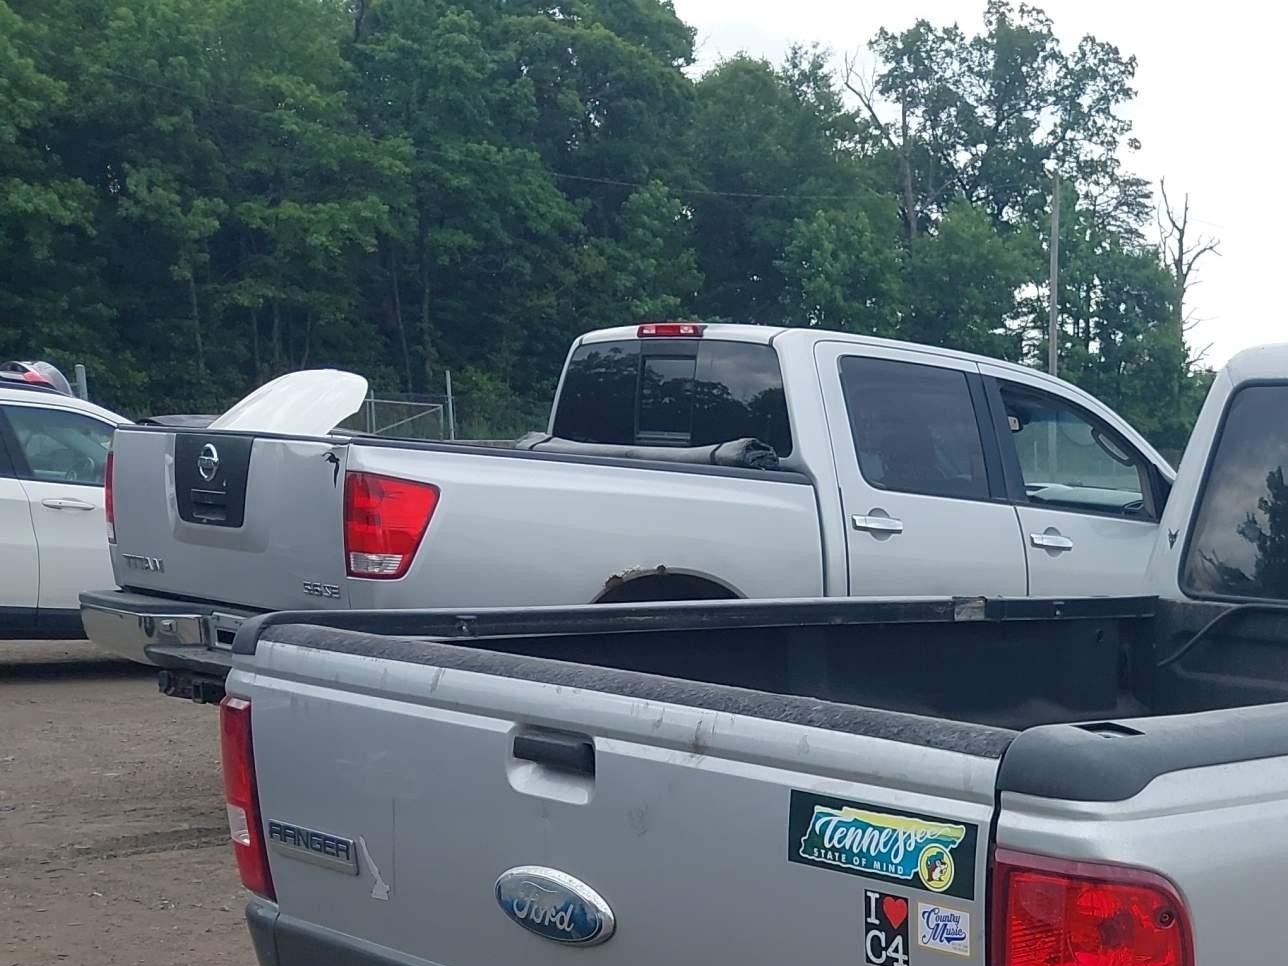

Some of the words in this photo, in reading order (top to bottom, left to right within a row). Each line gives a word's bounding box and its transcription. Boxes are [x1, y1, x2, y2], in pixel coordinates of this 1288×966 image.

[269, 821, 351, 861] RANGER
[815, 815, 946, 864] Tennessee
[813, 847, 847, 863] STATE
[852, 855, 867, 868] OF
[873, 861, 904, 875] MIND
[511, 880, 575, 933] Ford
[866, 891, 880, 925] I
[921, 907, 961, 930] Country
[921, 922, 966, 945] Music
